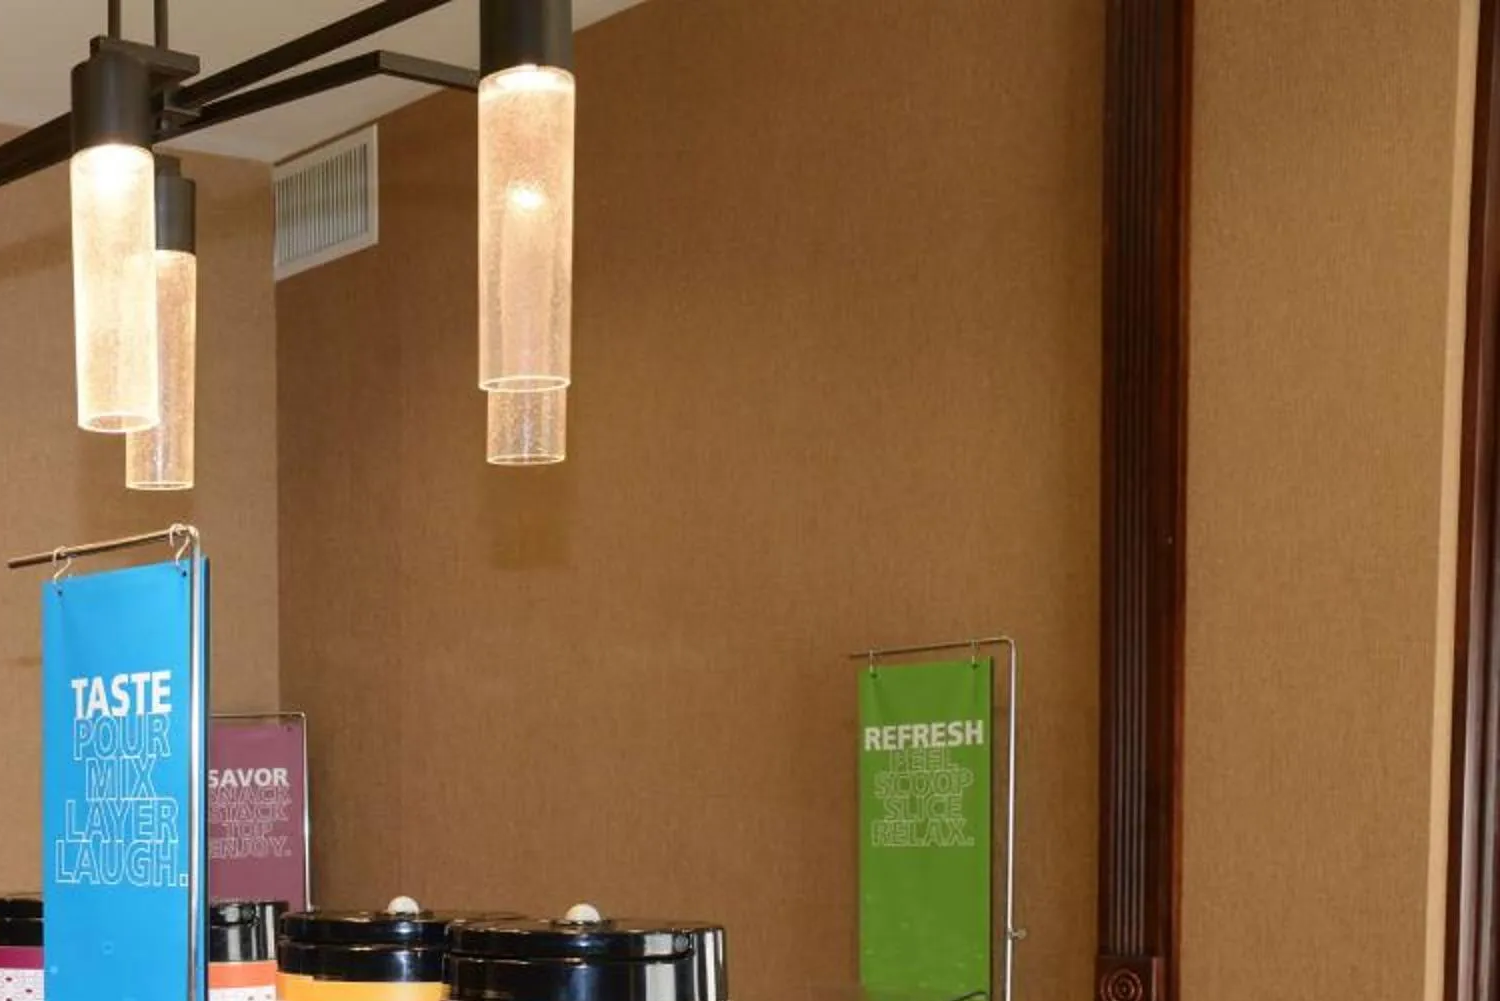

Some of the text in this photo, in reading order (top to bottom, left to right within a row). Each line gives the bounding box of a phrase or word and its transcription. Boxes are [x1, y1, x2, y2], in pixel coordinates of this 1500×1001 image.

[71, 670, 172, 719] TASTE
[73, 714, 172, 760] POUR
[864, 720, 985, 751] REFRESH
[86, 754, 157, 800] MIX
[208, 767, 290, 788] SAVOR
[65, 798, 179, 843] LAYER
[883, 794, 962, 820] SLICE
[55, 839, 190, 887] LAUGH.
